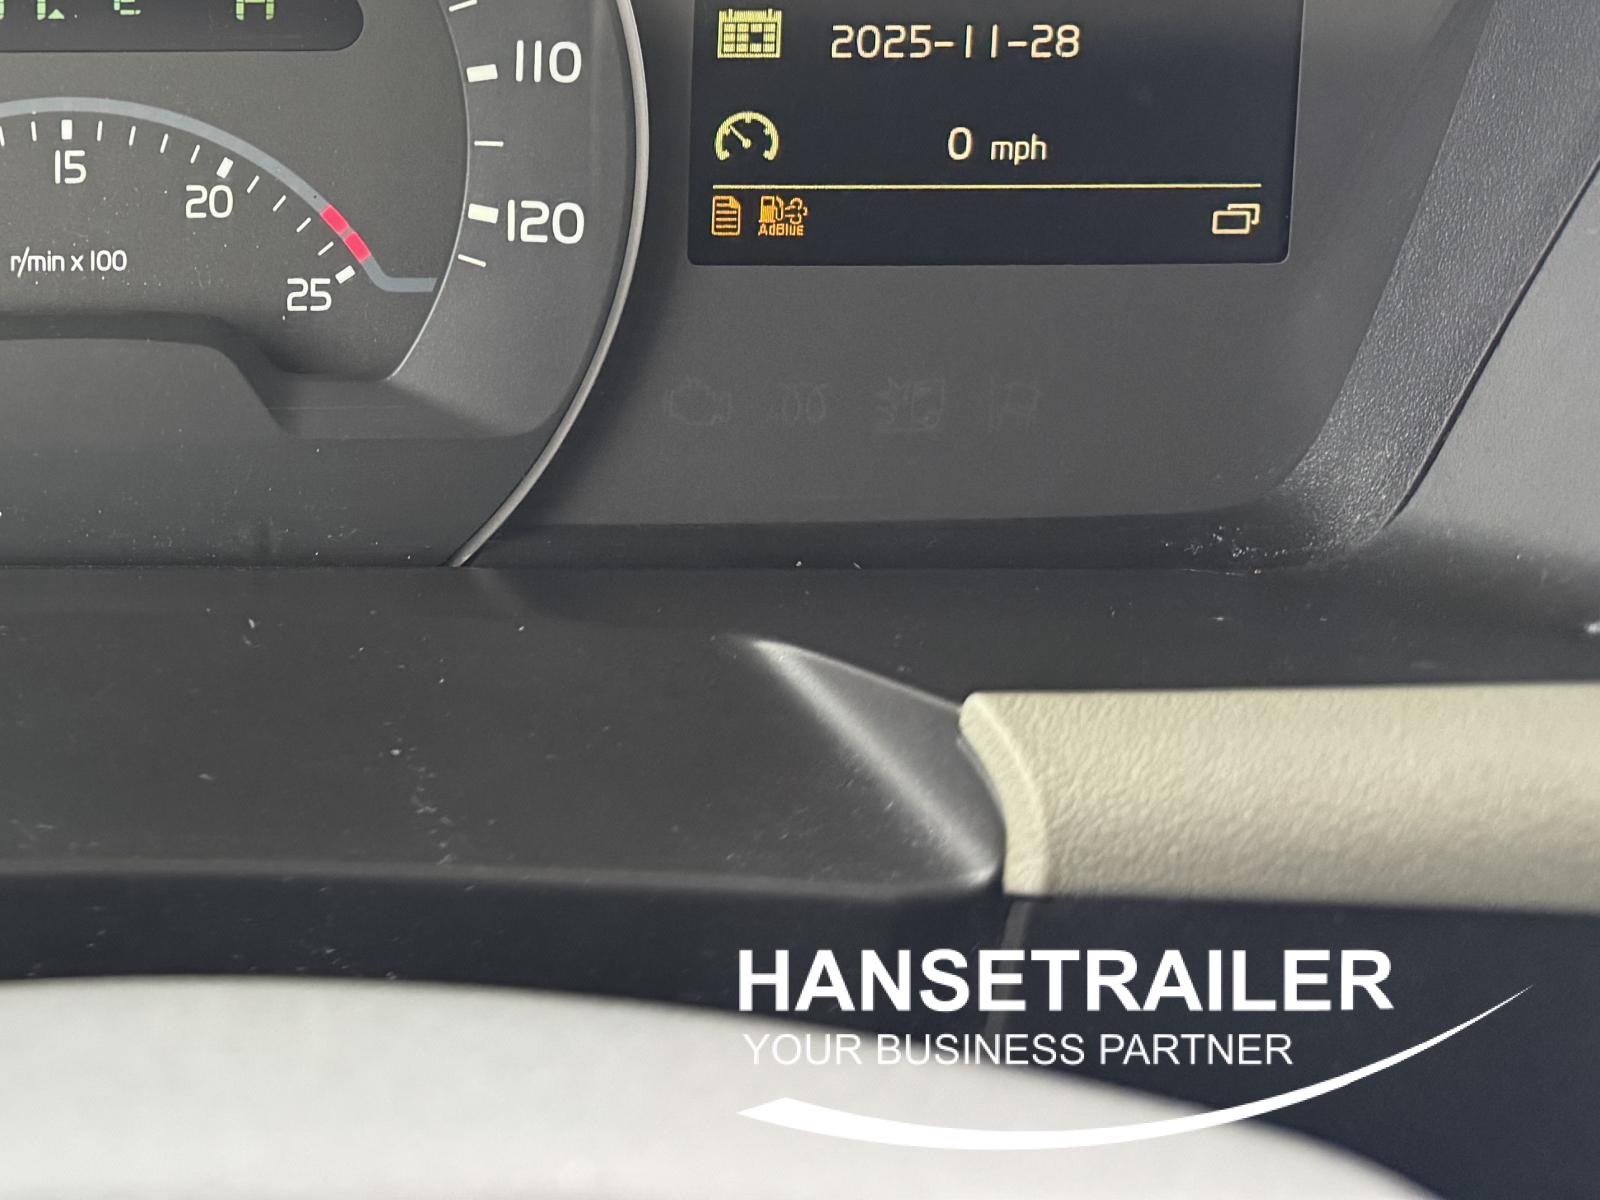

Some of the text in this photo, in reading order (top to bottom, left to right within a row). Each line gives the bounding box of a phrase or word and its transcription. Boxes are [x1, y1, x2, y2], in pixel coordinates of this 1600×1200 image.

[830, 23, 1082, 60] 2025-11-28
[514, 39, 583, 84] 110
[946, 126, 1048, 167] 0 mph
[53, 149, 88, 186] 15
[184, 184, 235, 220] 20
[505, 198, 586, 245] 120
[9, 245, 66, 278] r/min
[89, 249, 128, 273] 100
[285, 276, 332, 312] 25
